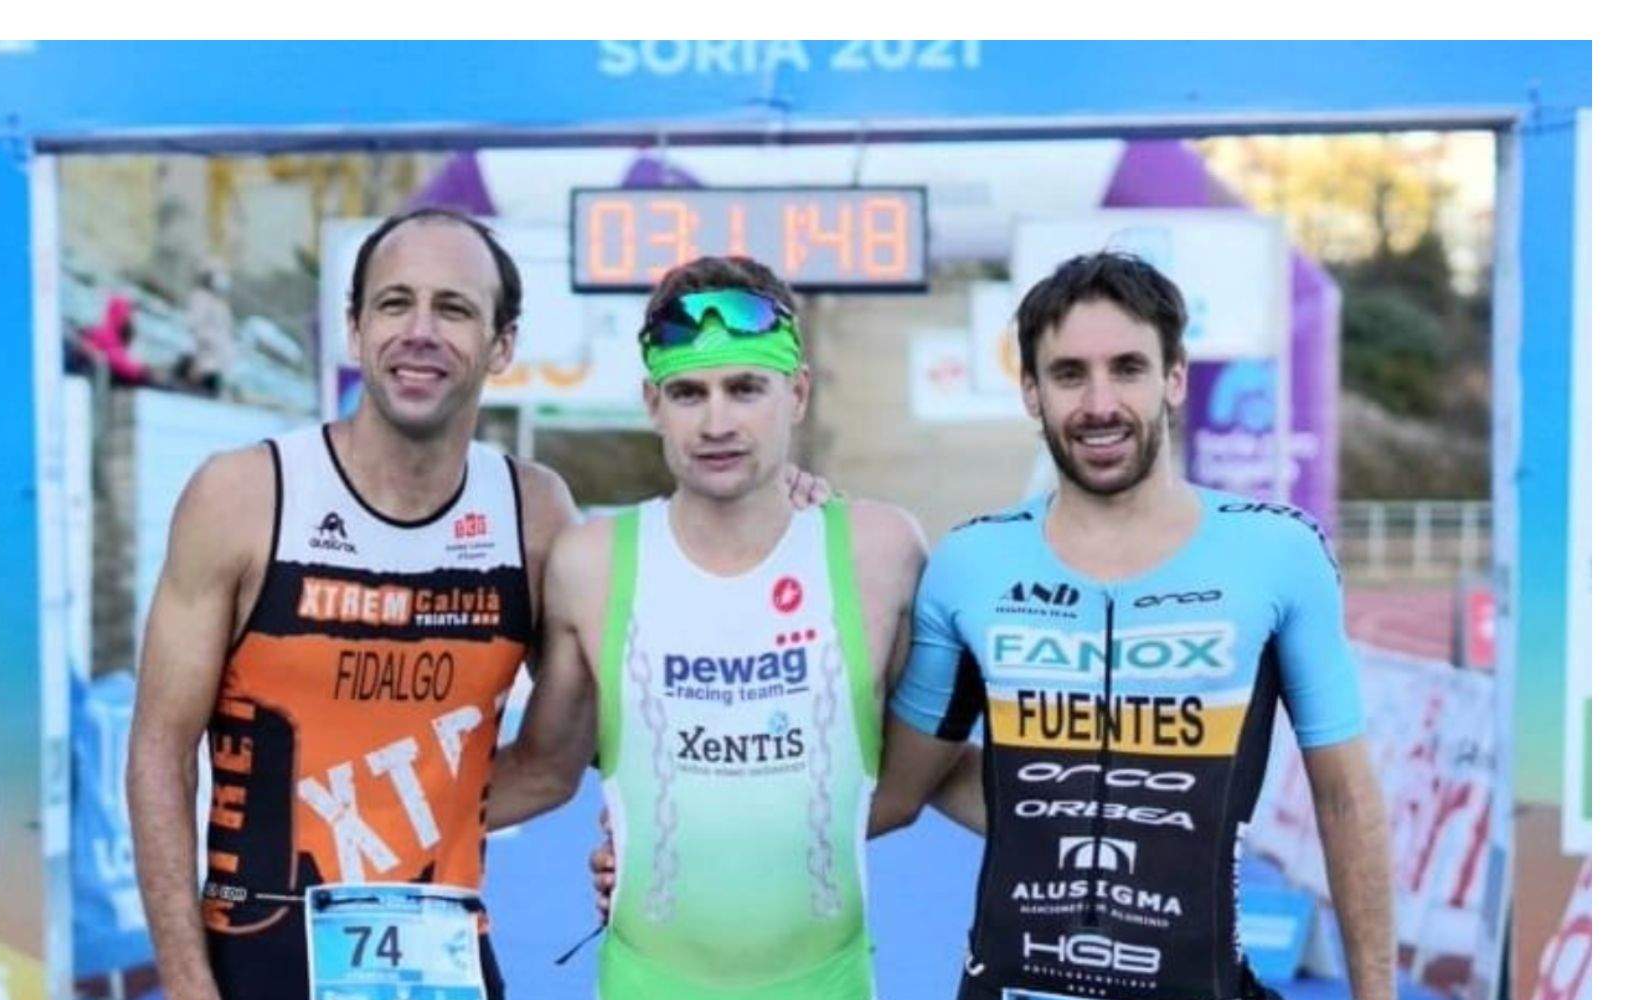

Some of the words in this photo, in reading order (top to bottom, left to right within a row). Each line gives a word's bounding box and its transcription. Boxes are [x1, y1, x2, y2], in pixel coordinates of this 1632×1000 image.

[597, 39, 810, 76] SORIA
[830, 39, 981, 69] 2021
[297, 576, 412, 626] XTREM
[663, 646, 808, 688] pewag
[992, 633, 1226, 673] FANOX
[334, 649, 456, 701] FIDALGO
[677, 684, 734, 706] racing
[740, 682, 786, 702] team
[1016, 690, 1205, 747] FUENTES
[1016, 762, 1196, 793] orca
[1014, 799, 1196, 832] ORBEA
[1011, 878, 1183, 916] ALUSIGMA
[342, 925, 403, 969] 74
[1022, 930, 1162, 975] HGB
